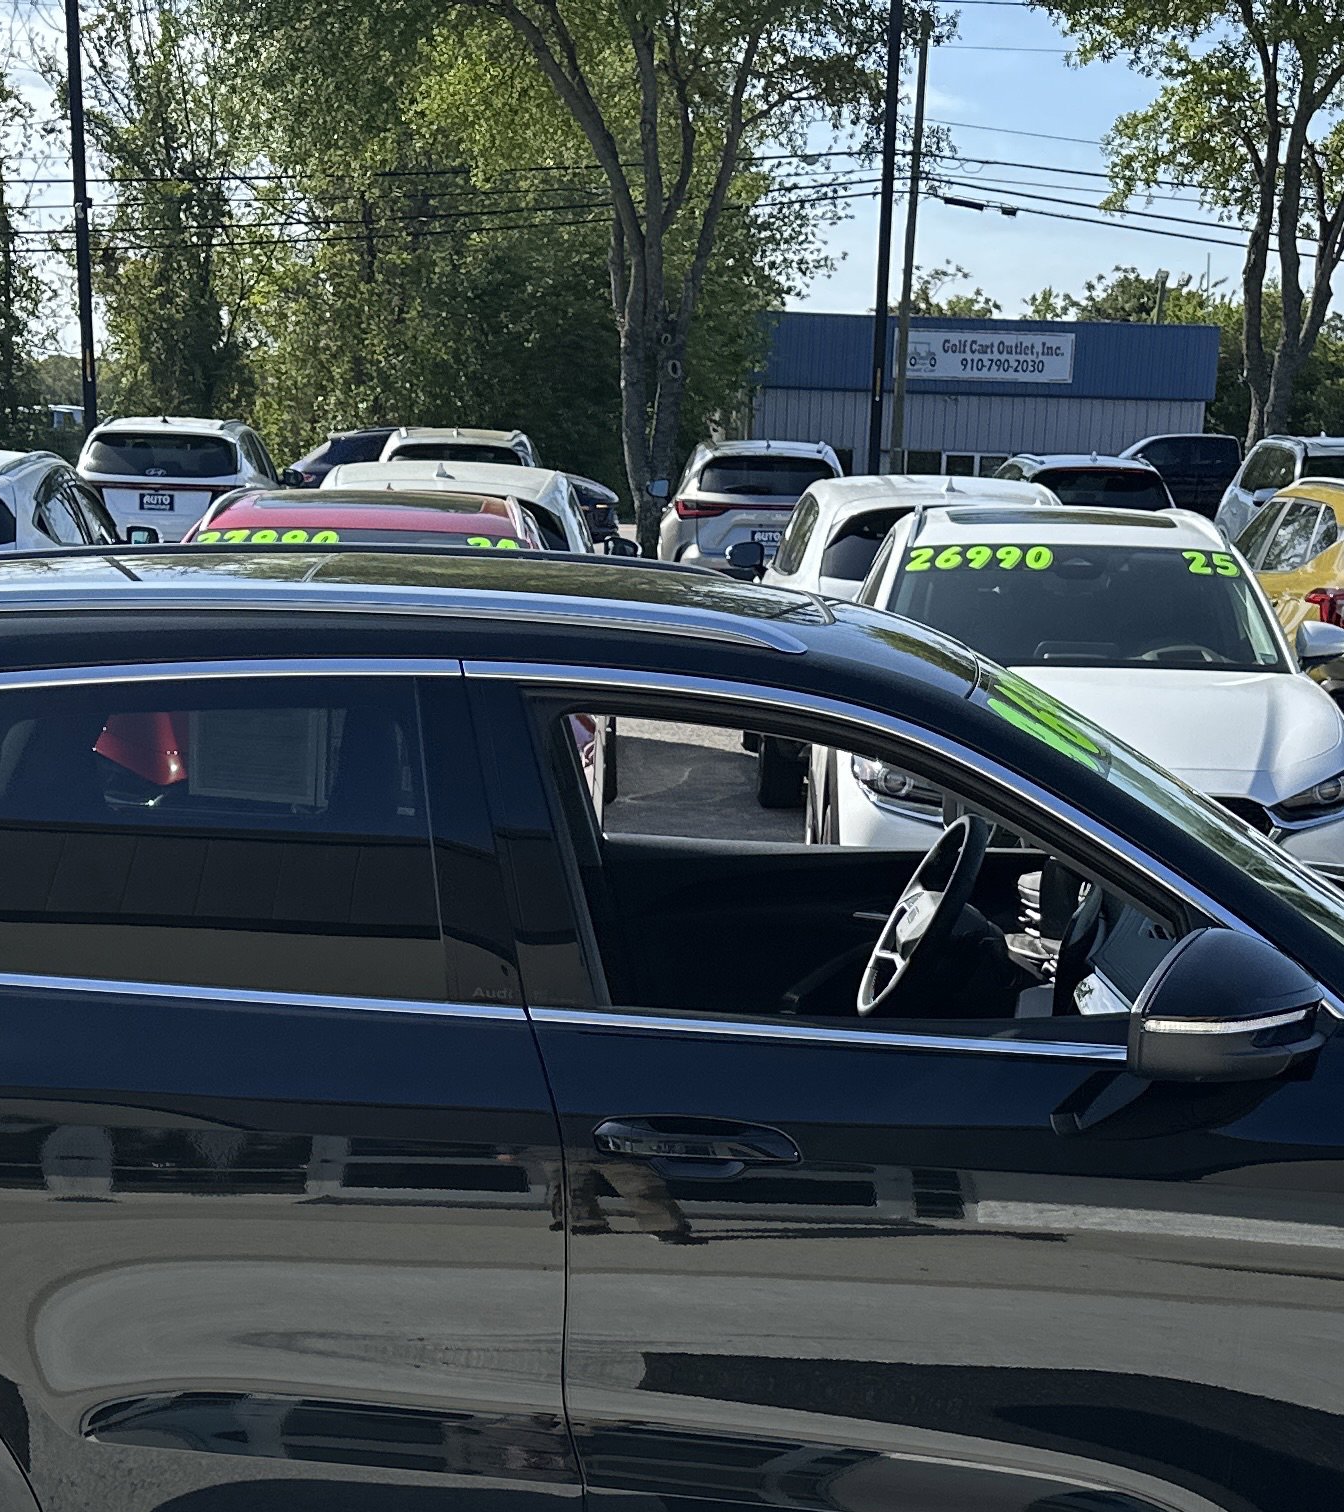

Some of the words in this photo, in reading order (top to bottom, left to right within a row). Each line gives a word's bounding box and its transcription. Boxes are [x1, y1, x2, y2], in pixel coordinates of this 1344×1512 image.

[942, 339, 967, 354] Golf
[969, 340, 995, 355] Cart
[997, 341, 1040, 359] Outlet,
[1041, 342, 1065, 357] Inc.
[960, 358, 1045, 373] 910-790-2030
[143, 494, 171, 505] AUTO
[754, 531, 781, 541] AUTO
[905, 546, 1054, 571] 26990
[1182, 551, 1240, 577] 25
